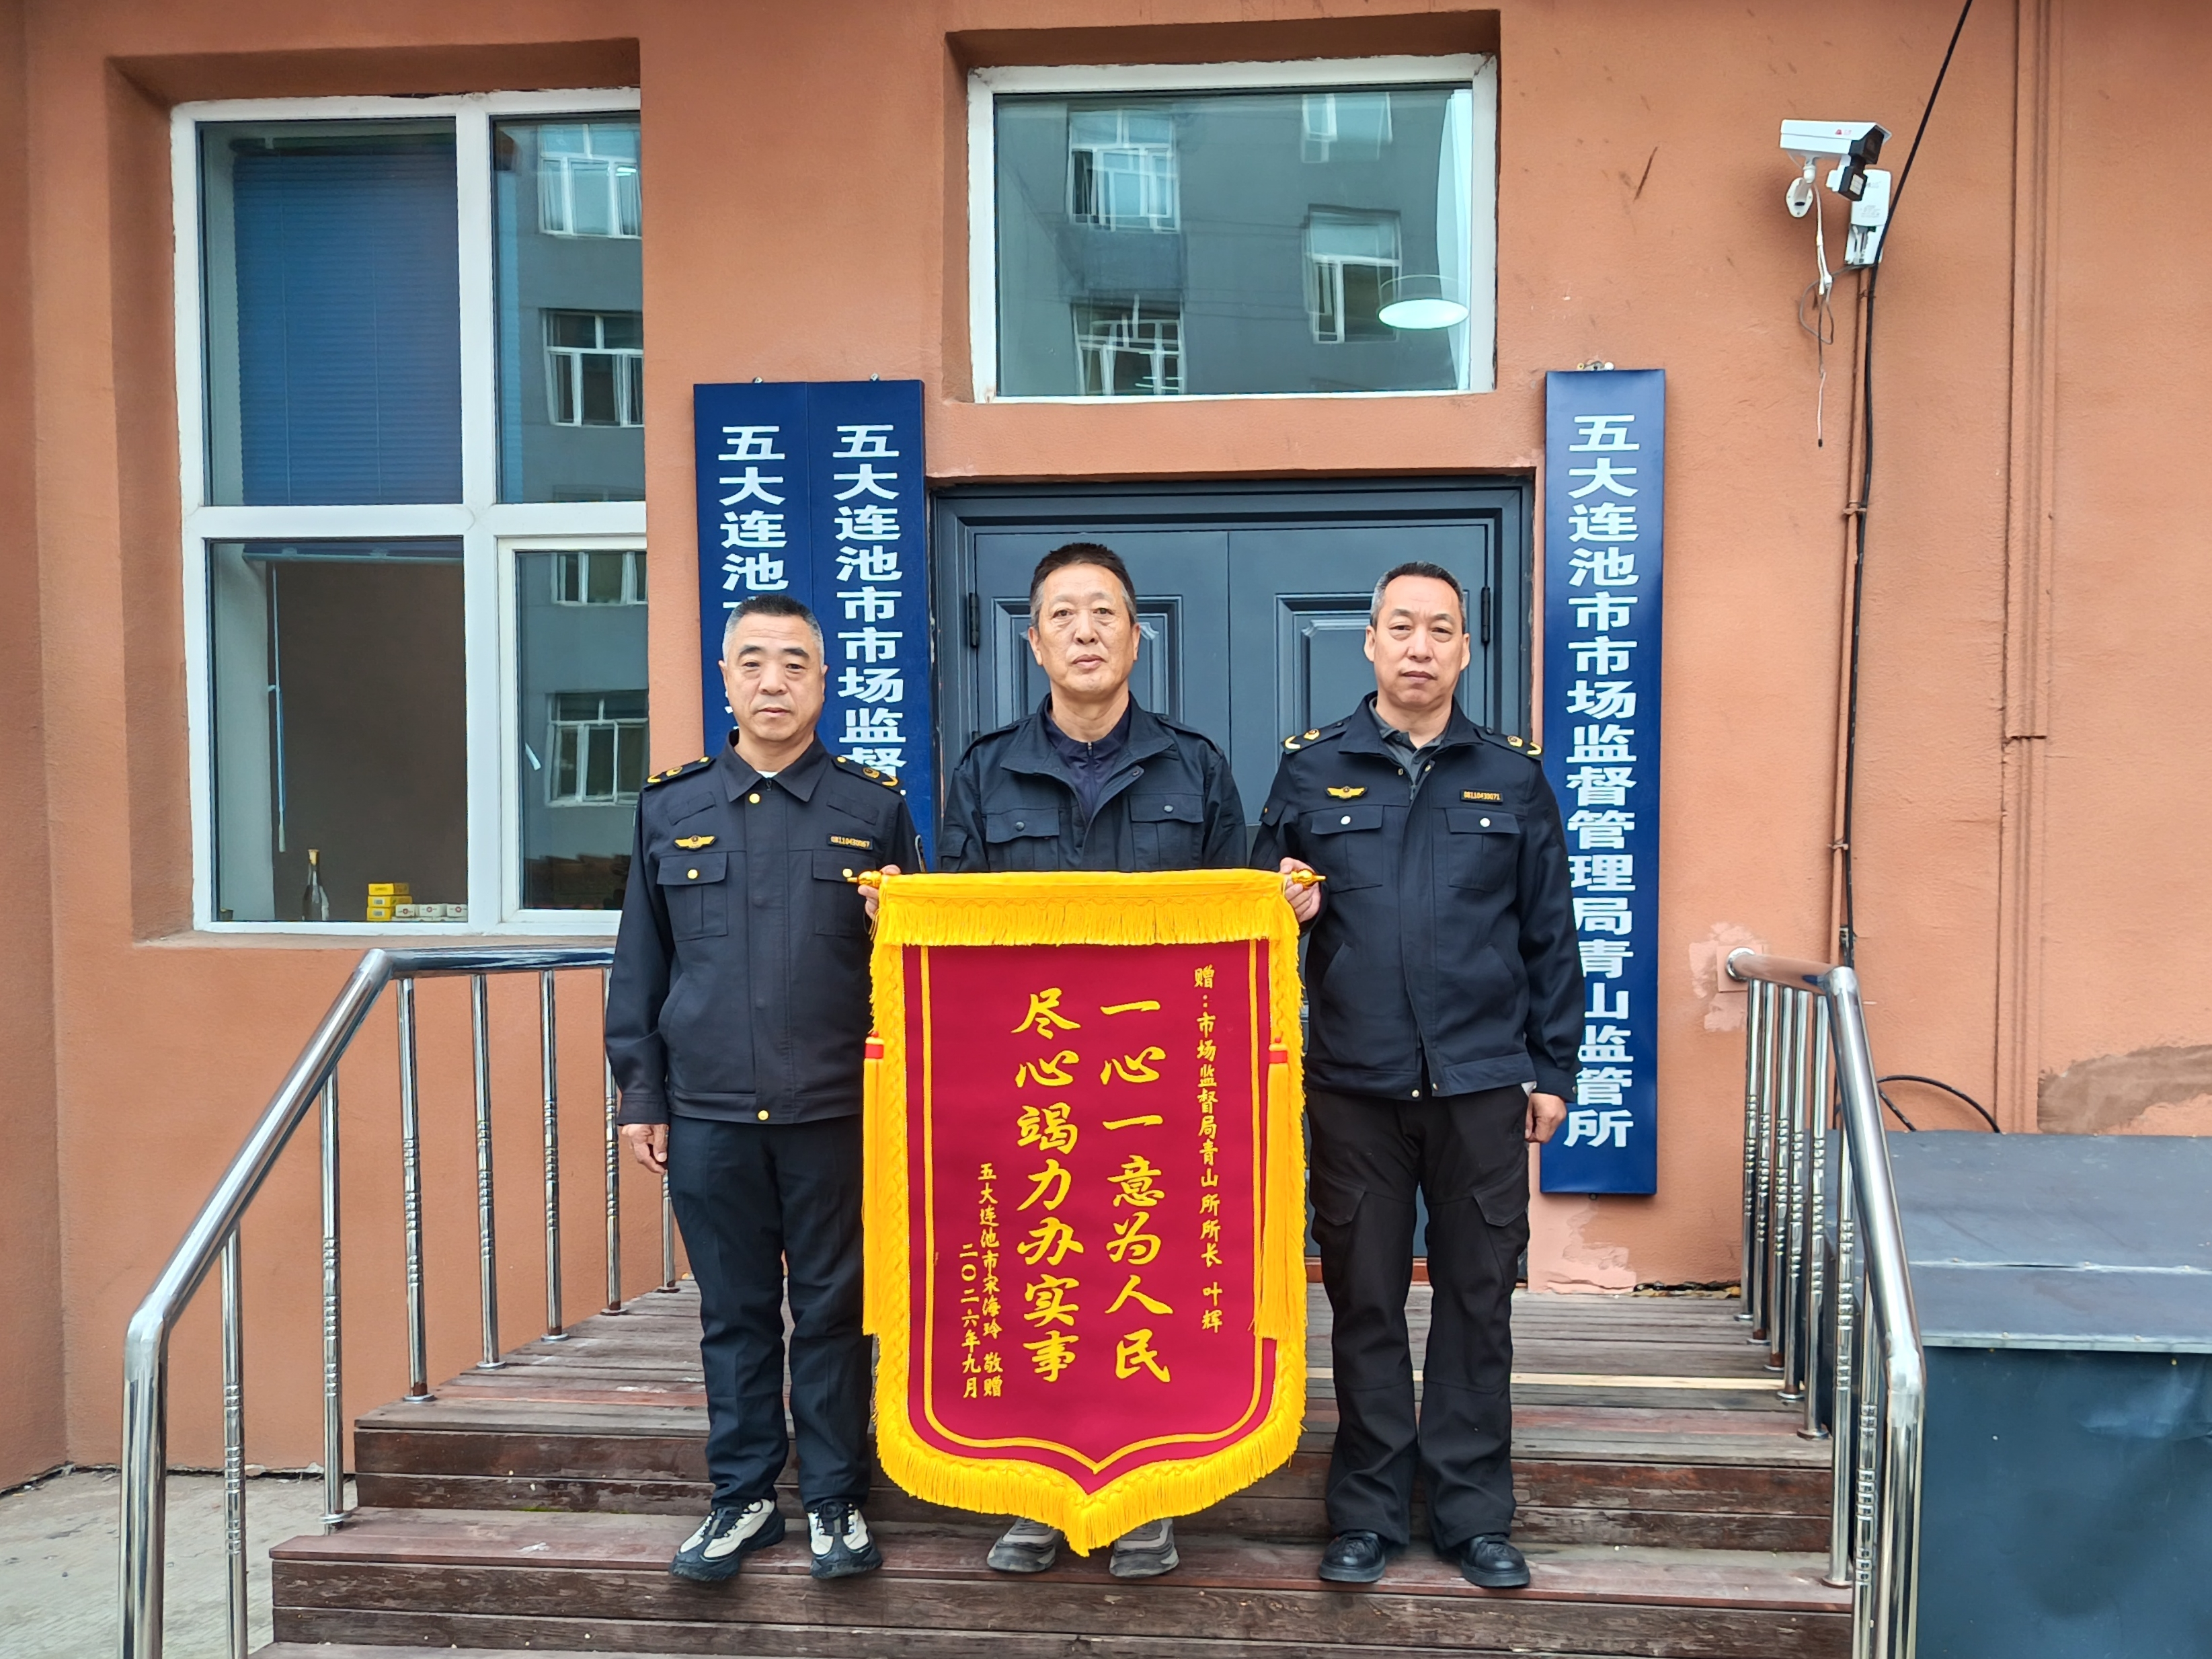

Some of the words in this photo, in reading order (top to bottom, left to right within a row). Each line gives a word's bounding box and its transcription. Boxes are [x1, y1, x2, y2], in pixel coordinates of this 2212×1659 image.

[718, 426, 789, 608] 五大连池
[1564, 414, 1640, 1147] 五大连池市市场监督管理局青山监管所
[1011, 987, 1084, 1383] 尽心竭力办实事
[1100, 999, 1173, 1383] 一心一意为人民
